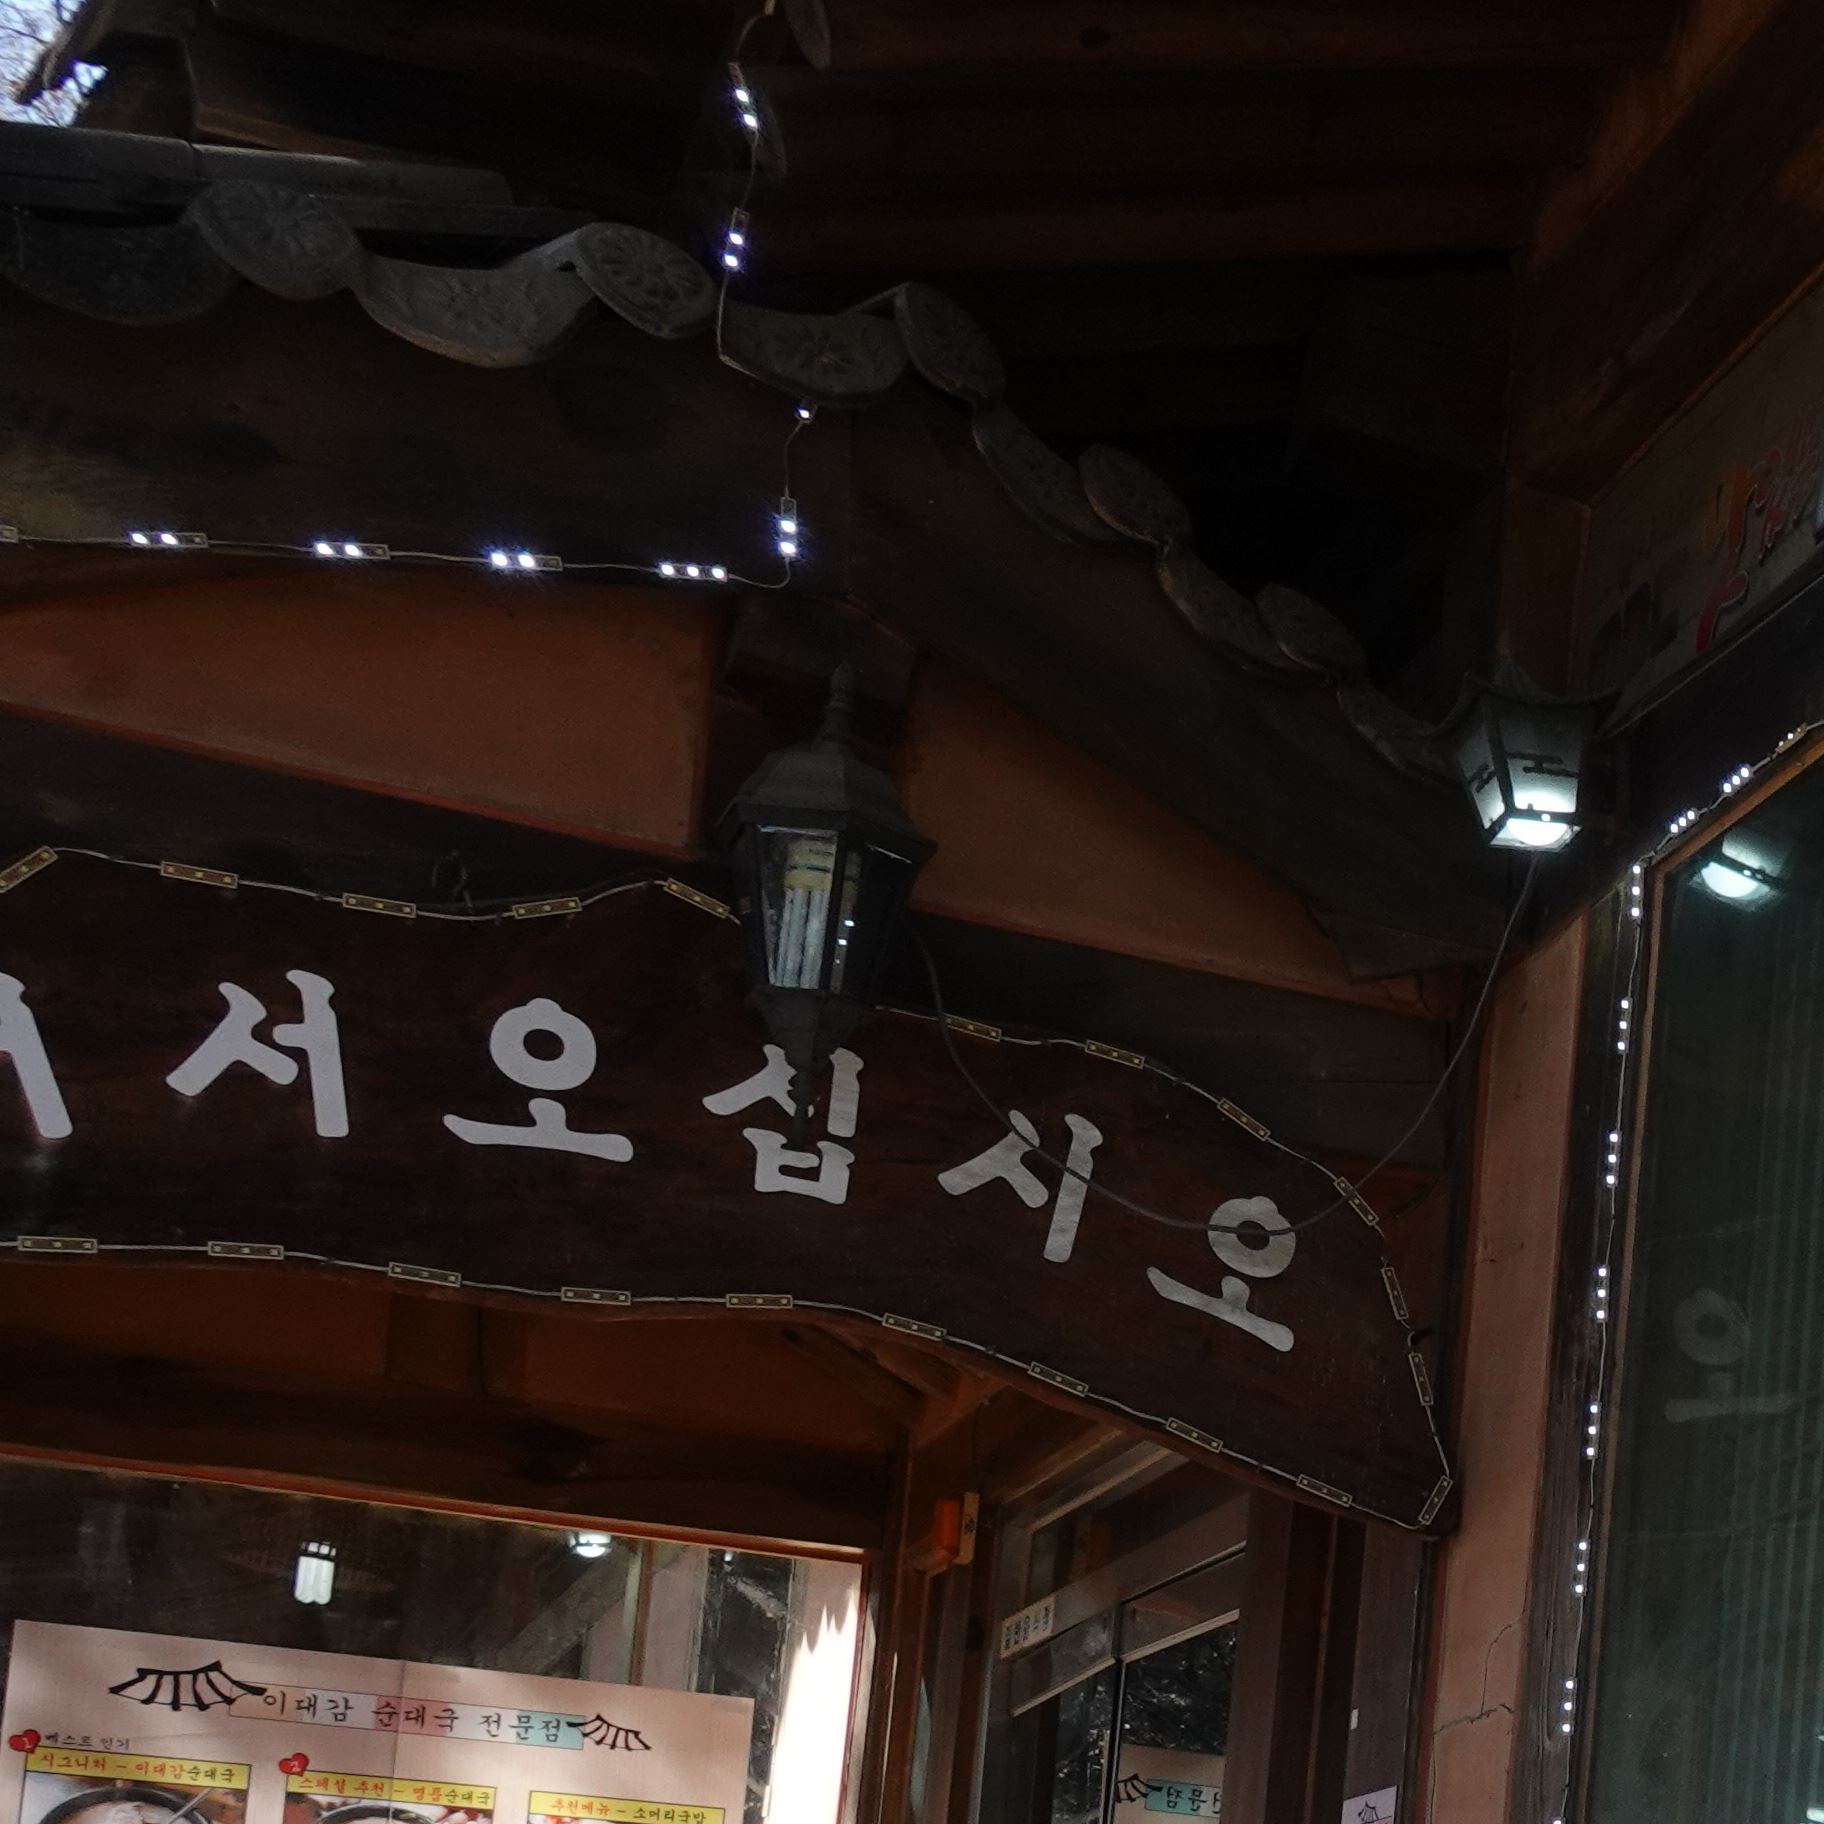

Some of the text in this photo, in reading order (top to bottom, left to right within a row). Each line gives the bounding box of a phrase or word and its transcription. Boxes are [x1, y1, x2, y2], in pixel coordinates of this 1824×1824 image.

[263, 1690, 562, 1743] 이대감 순대국 전문점
[101, 1738, 131, 1751] 인기
[40, 1752, 108, 1771] 시그니처
[135, 1762, 236, 1783] 이대감순대국
[300, 1777, 347, 1794] 스페셜
[355, 1780, 386, 1797] 추천
[412, 1785, 490, 1806] 명품순대국
[551, 1798, 611, 1816] 추천메뉴
